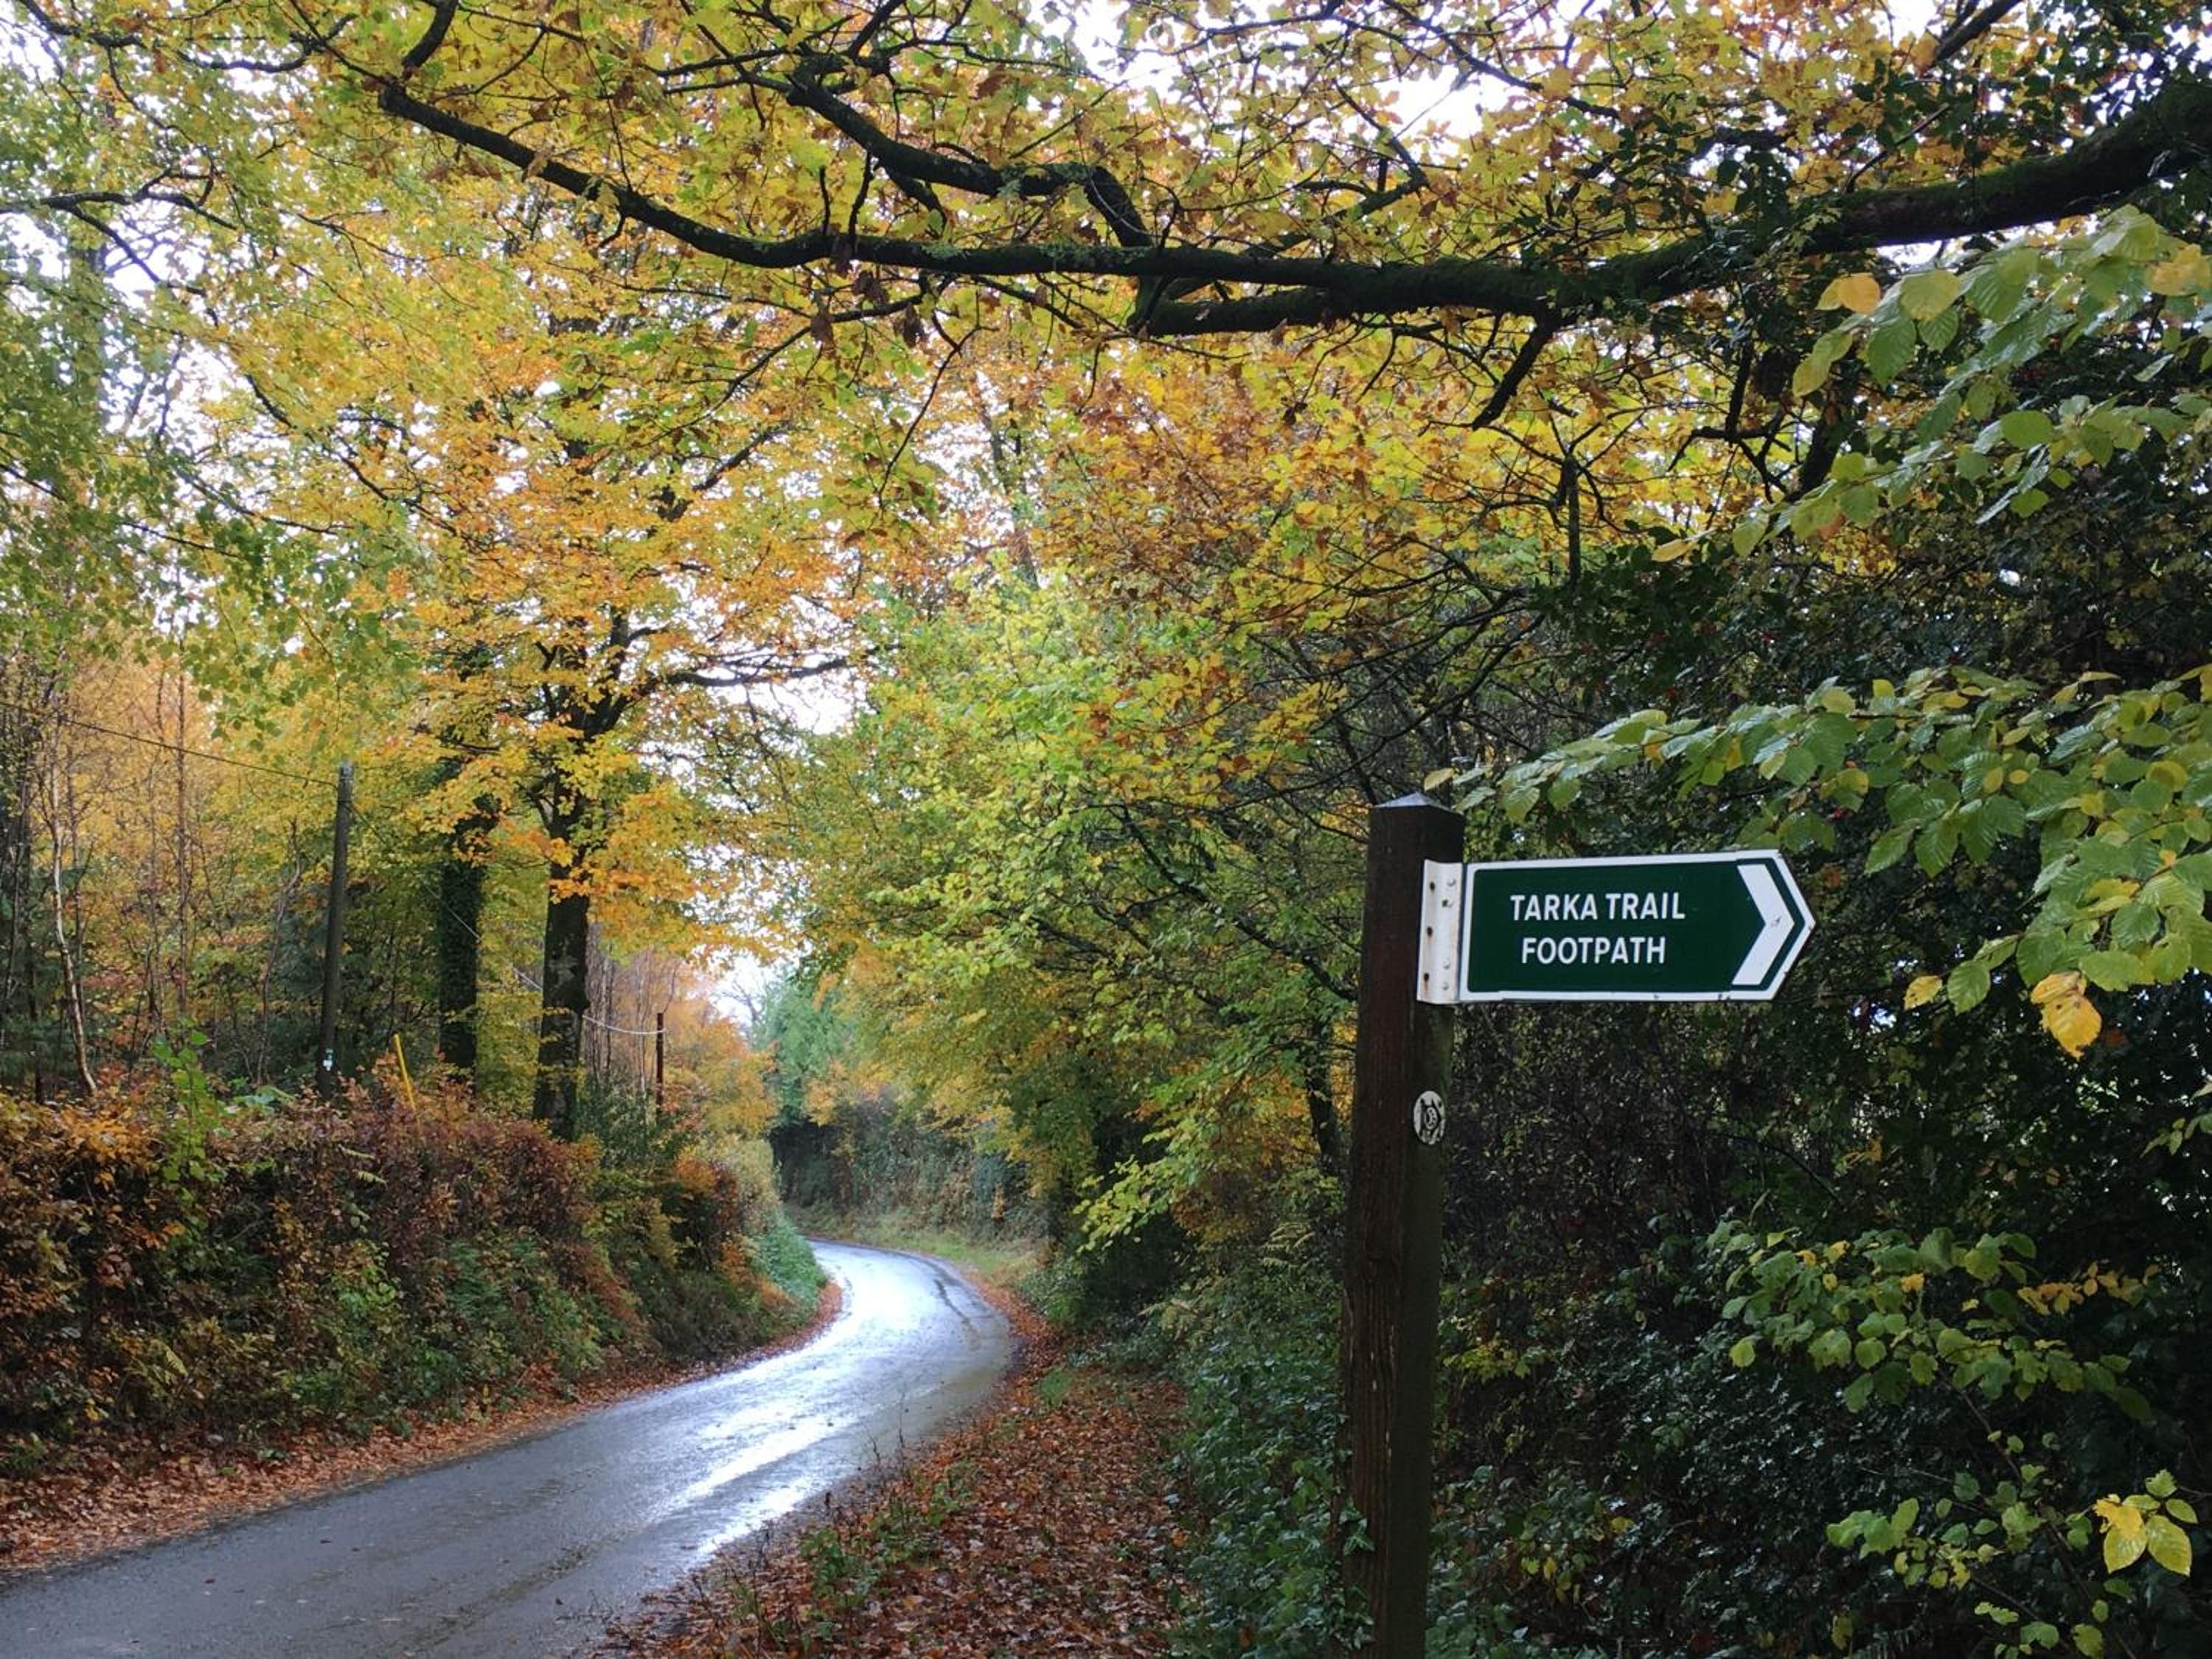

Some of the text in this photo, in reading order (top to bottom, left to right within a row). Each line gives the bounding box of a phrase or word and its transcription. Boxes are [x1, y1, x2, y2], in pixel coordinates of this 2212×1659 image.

[1509, 891, 1686, 921] TARKA TRAIL
[1521, 936, 1666, 964] FOOTPATH
